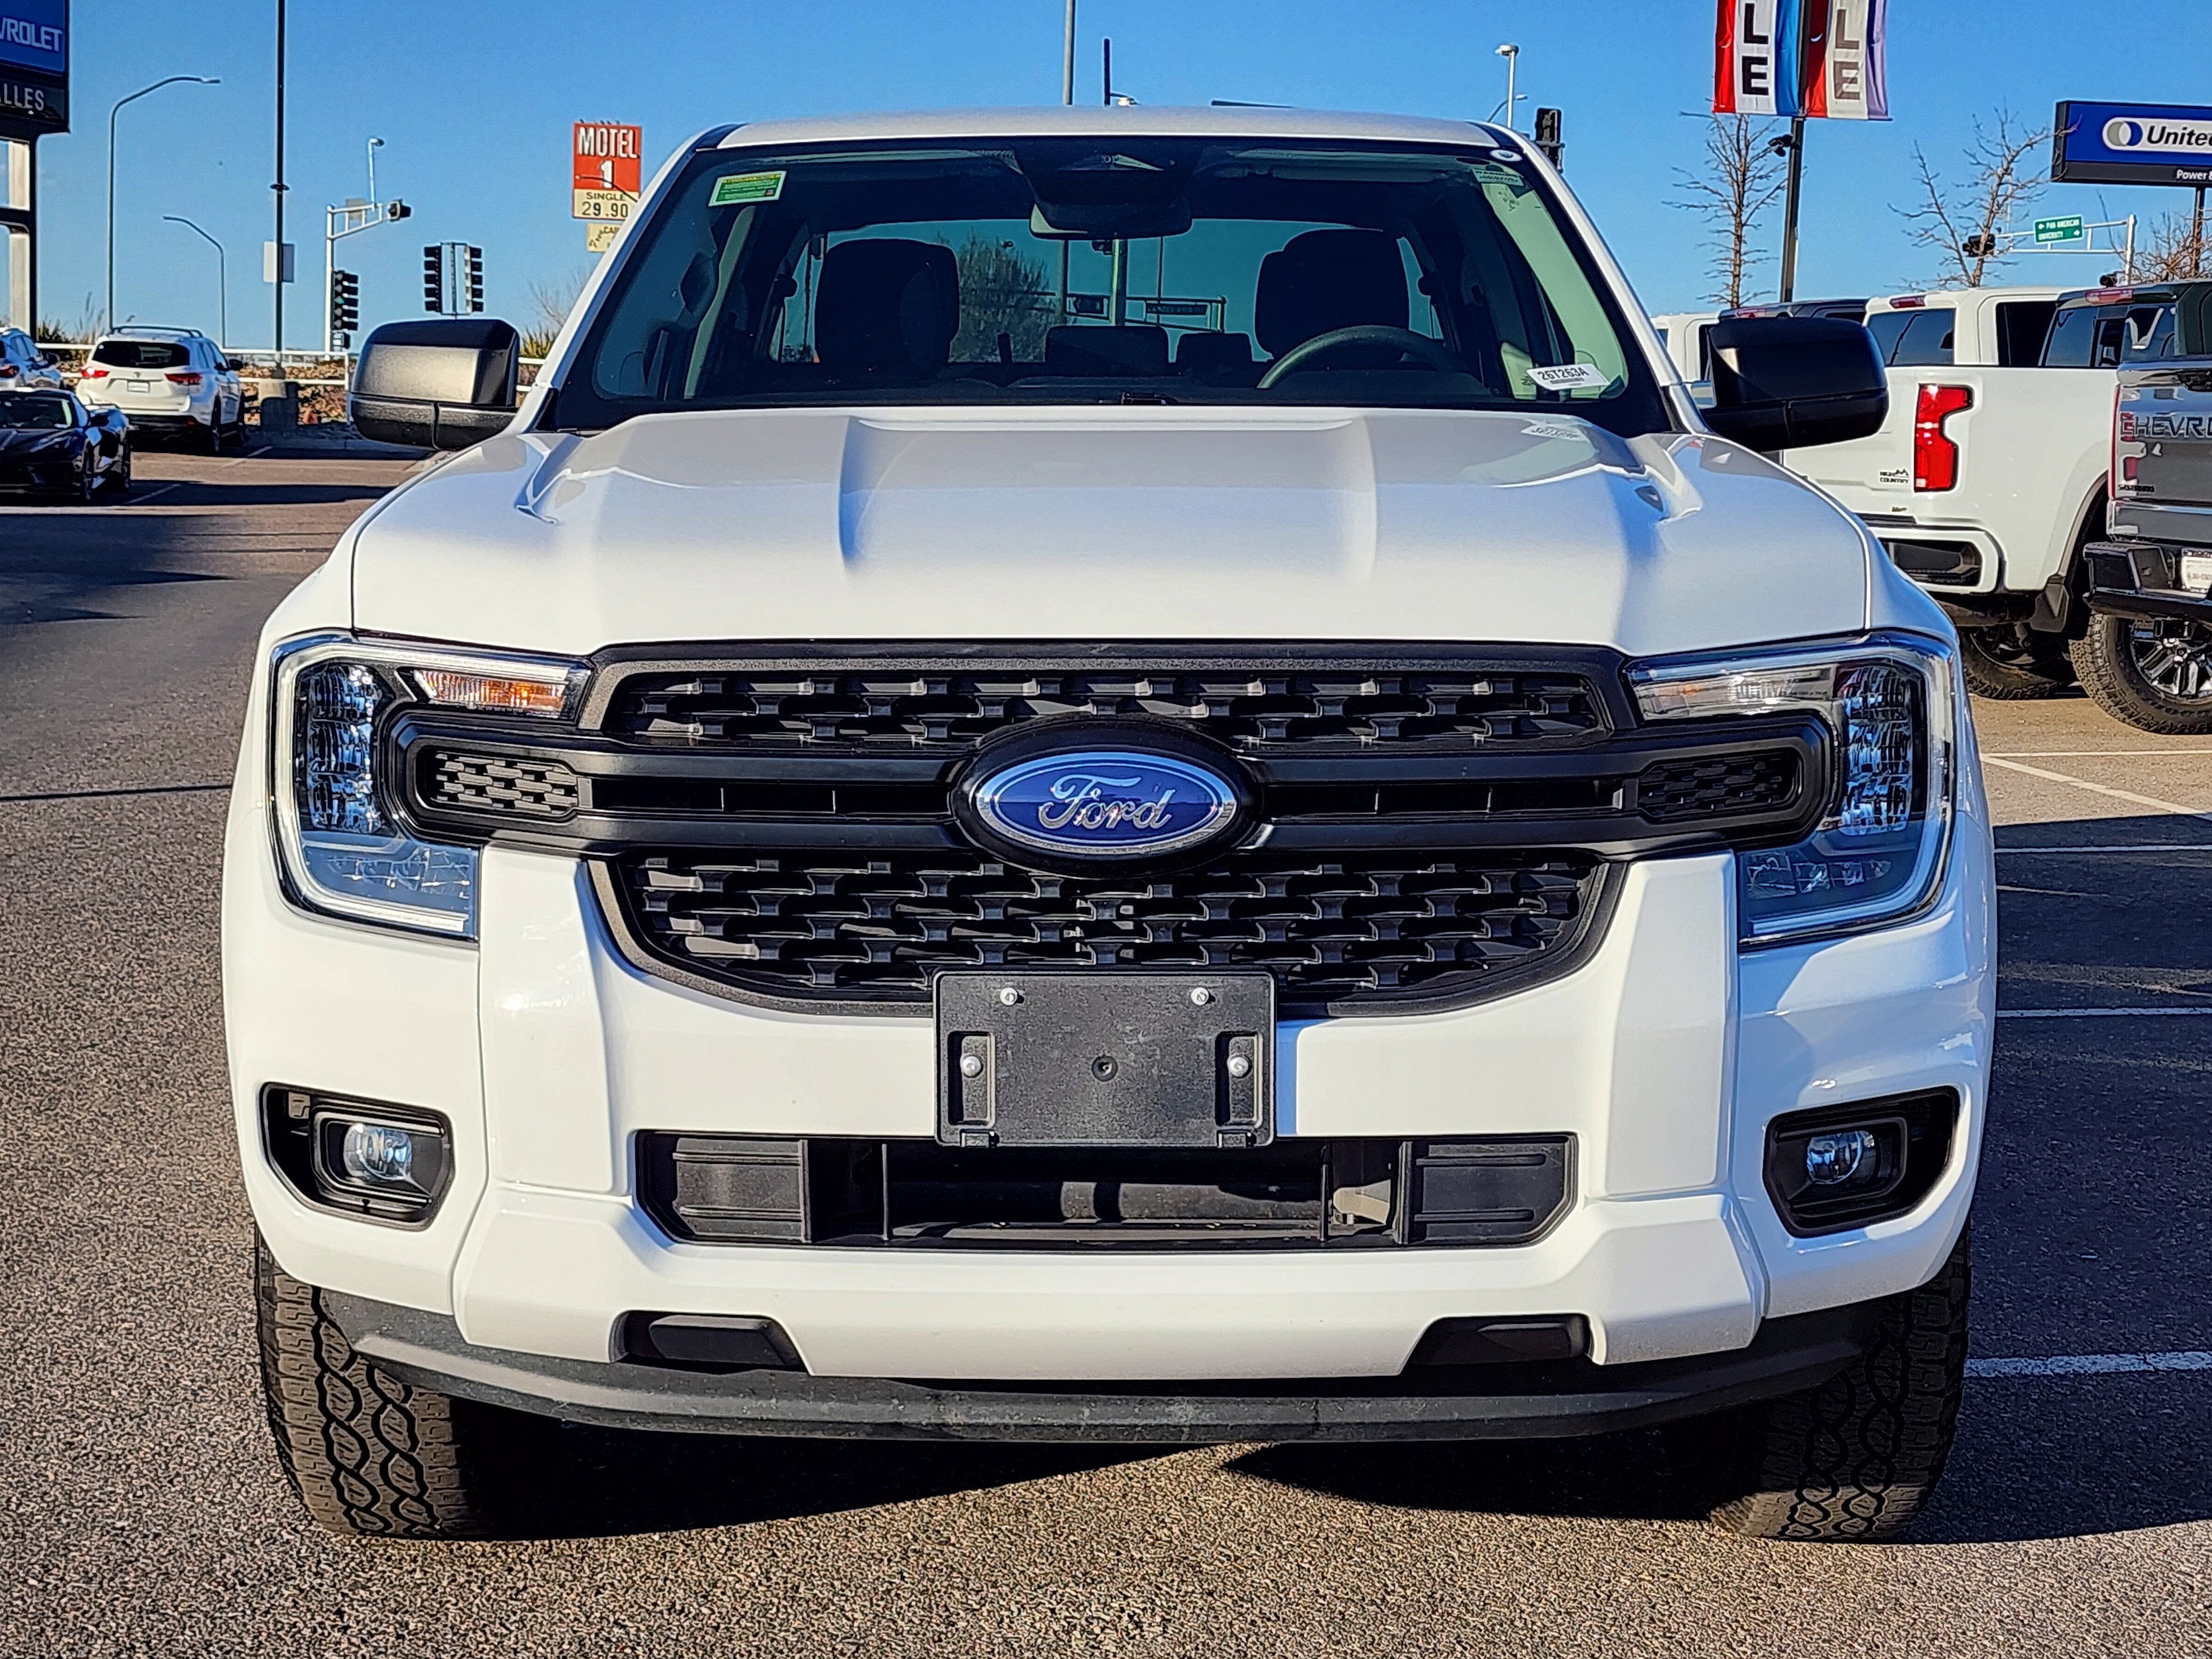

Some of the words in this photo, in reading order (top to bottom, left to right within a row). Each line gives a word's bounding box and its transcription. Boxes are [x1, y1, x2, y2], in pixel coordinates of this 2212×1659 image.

[0, 83, 44, 111] LLES
[578, 127, 638, 158] MOTEL
[601, 160, 613, 188] 1
[2177, 169, 2208, 180] Power
[586, 192, 626, 201] SINGLE
[582, 201, 629, 217] 29.90
[1537, 367, 1590, 380] 26T263A
[1038, 774, 1176, 829] Ford
